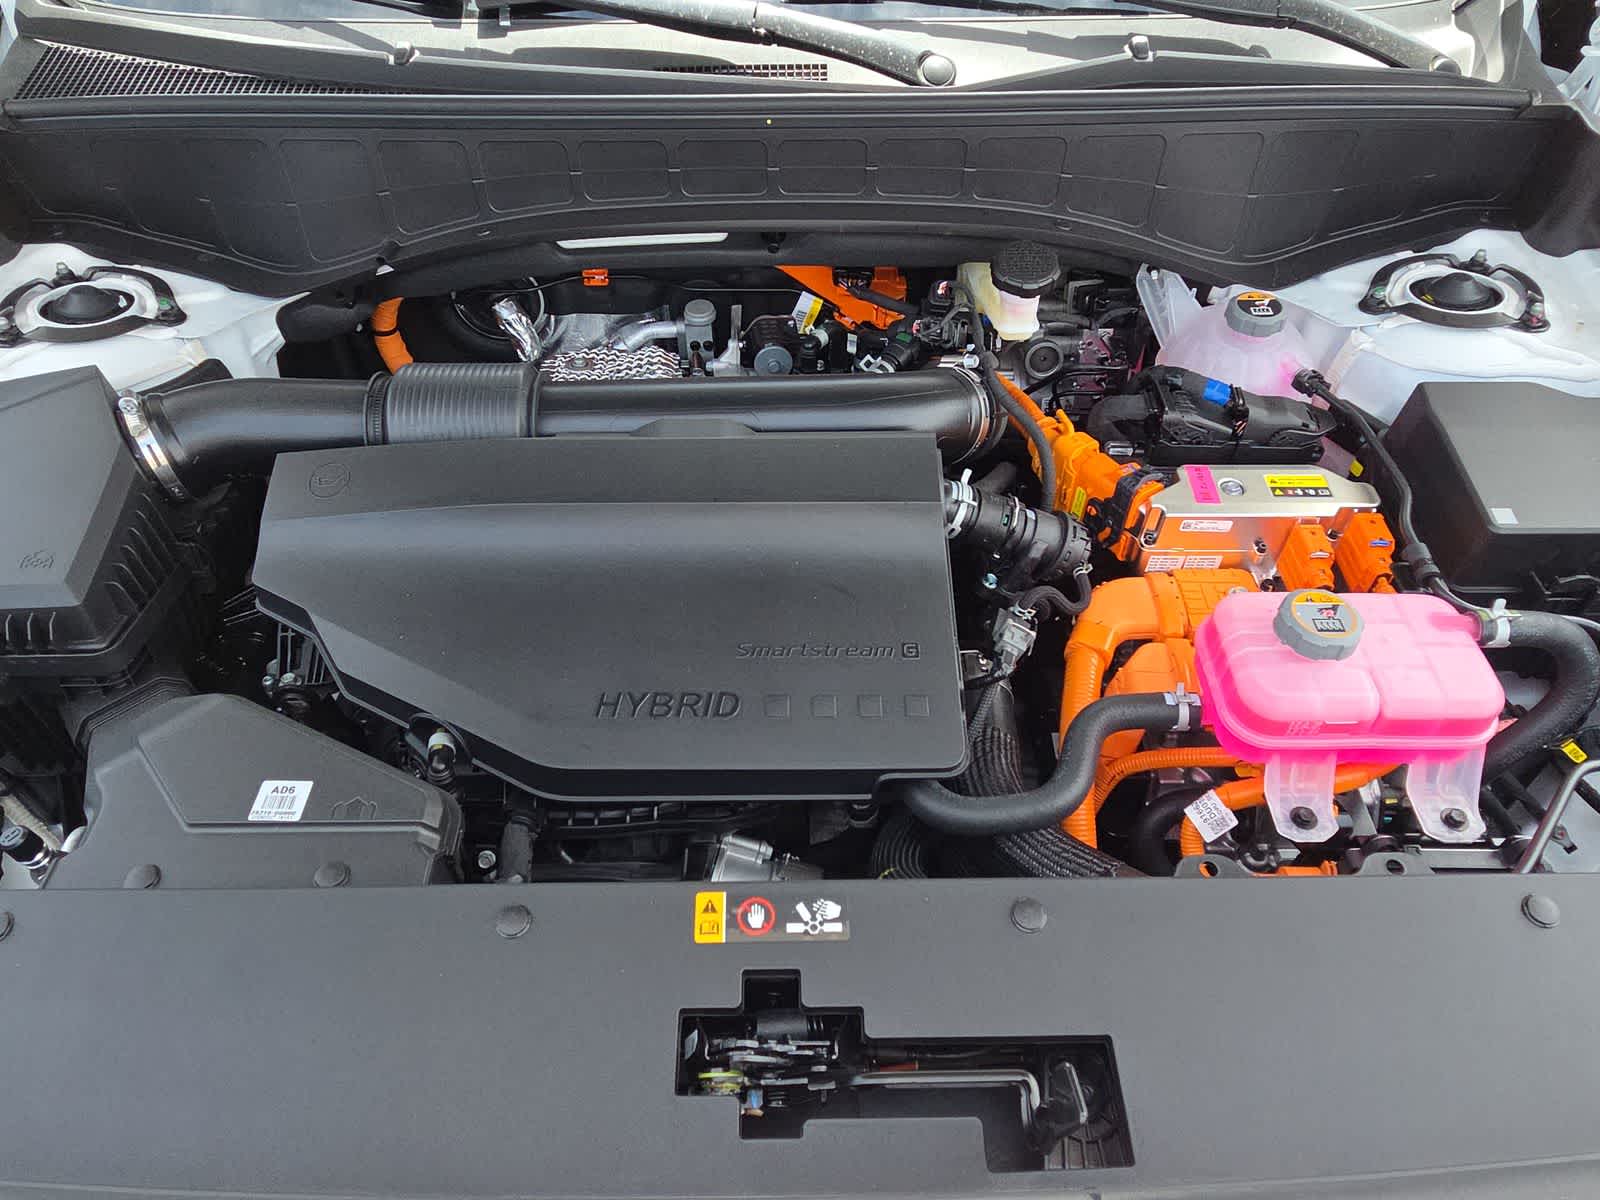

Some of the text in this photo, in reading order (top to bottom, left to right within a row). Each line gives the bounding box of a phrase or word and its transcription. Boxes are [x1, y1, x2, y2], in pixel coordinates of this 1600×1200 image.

[735, 642, 895, 660] Smartstream
[595, 691, 741, 719] HYBRID
[270, 785, 296, 795] AD6
